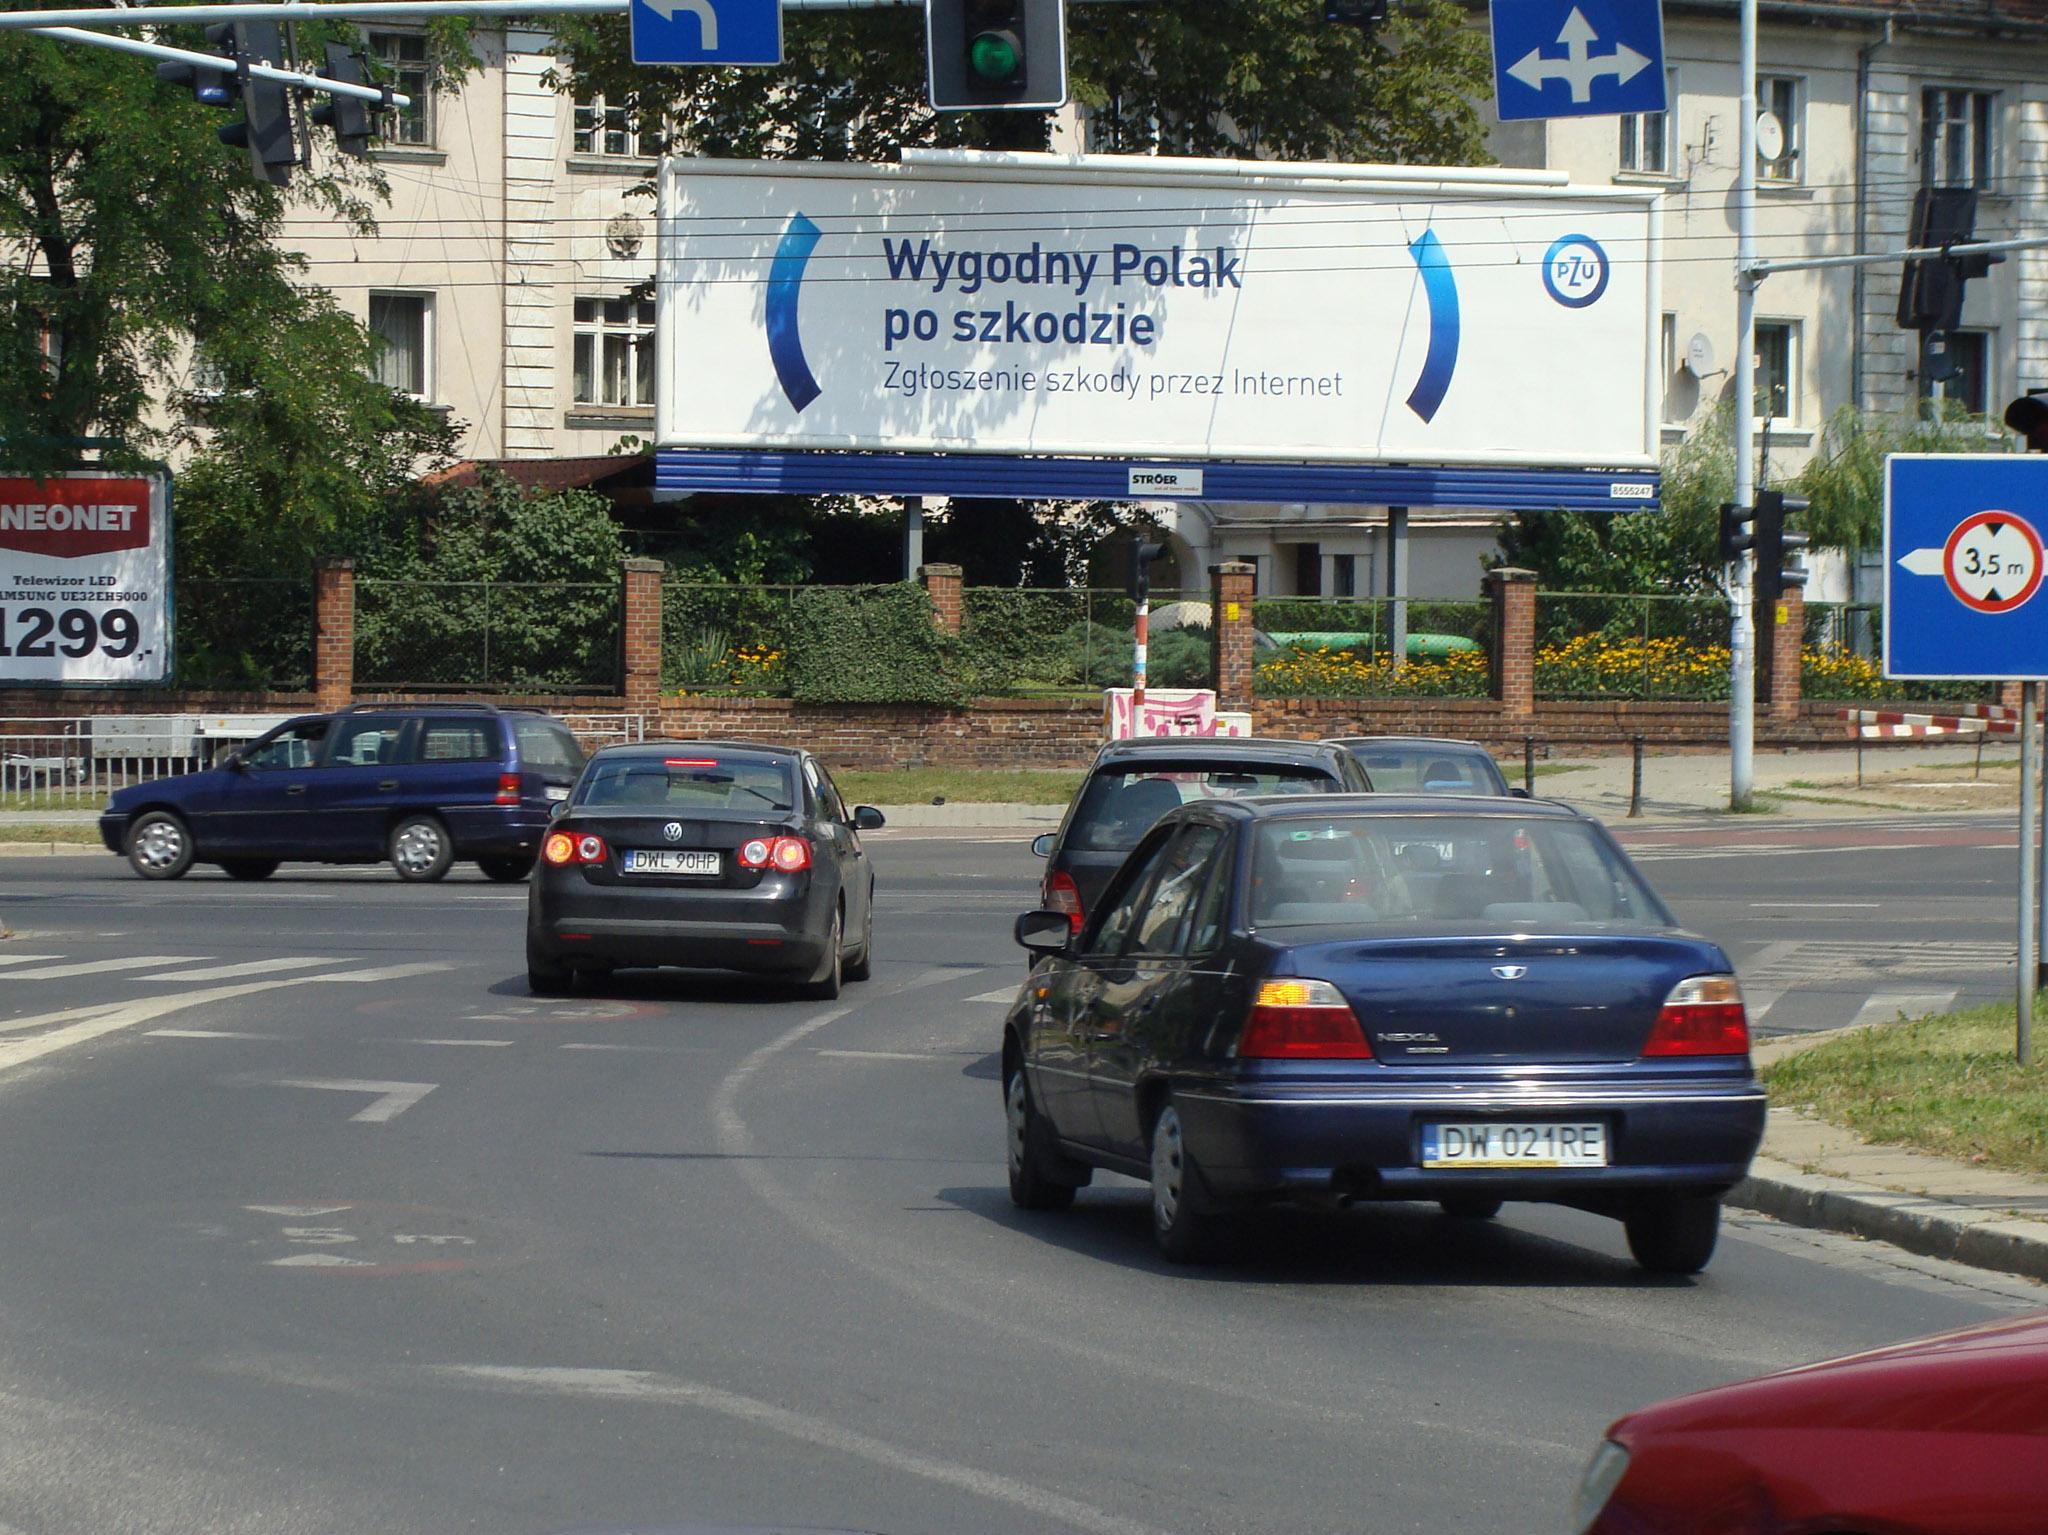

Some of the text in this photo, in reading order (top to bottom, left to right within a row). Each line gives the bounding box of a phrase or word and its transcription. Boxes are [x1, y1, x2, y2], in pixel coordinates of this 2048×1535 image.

[883, 238, 1242, 296] Wygodny Polak
[1557, 255, 1595, 287] PZU
[885, 300, 1155, 351] po szkodzie
[883, 361, 1343, 402] Zgłoszenie szkody przez Internet
[0, 504, 137, 531] NEONET
[1964, 547, 2024, 578] 3,5 m
[13, 575, 117, 586] Telewizor LED
[61, 591, 148, 602] UE32EH5000
[636, 852, 670, 868] DWL
[676, 852, 717, 869] 90HP
[1444, 1126, 1489, 1158] DW
[1501, 1126, 1600, 1158] 021RE
